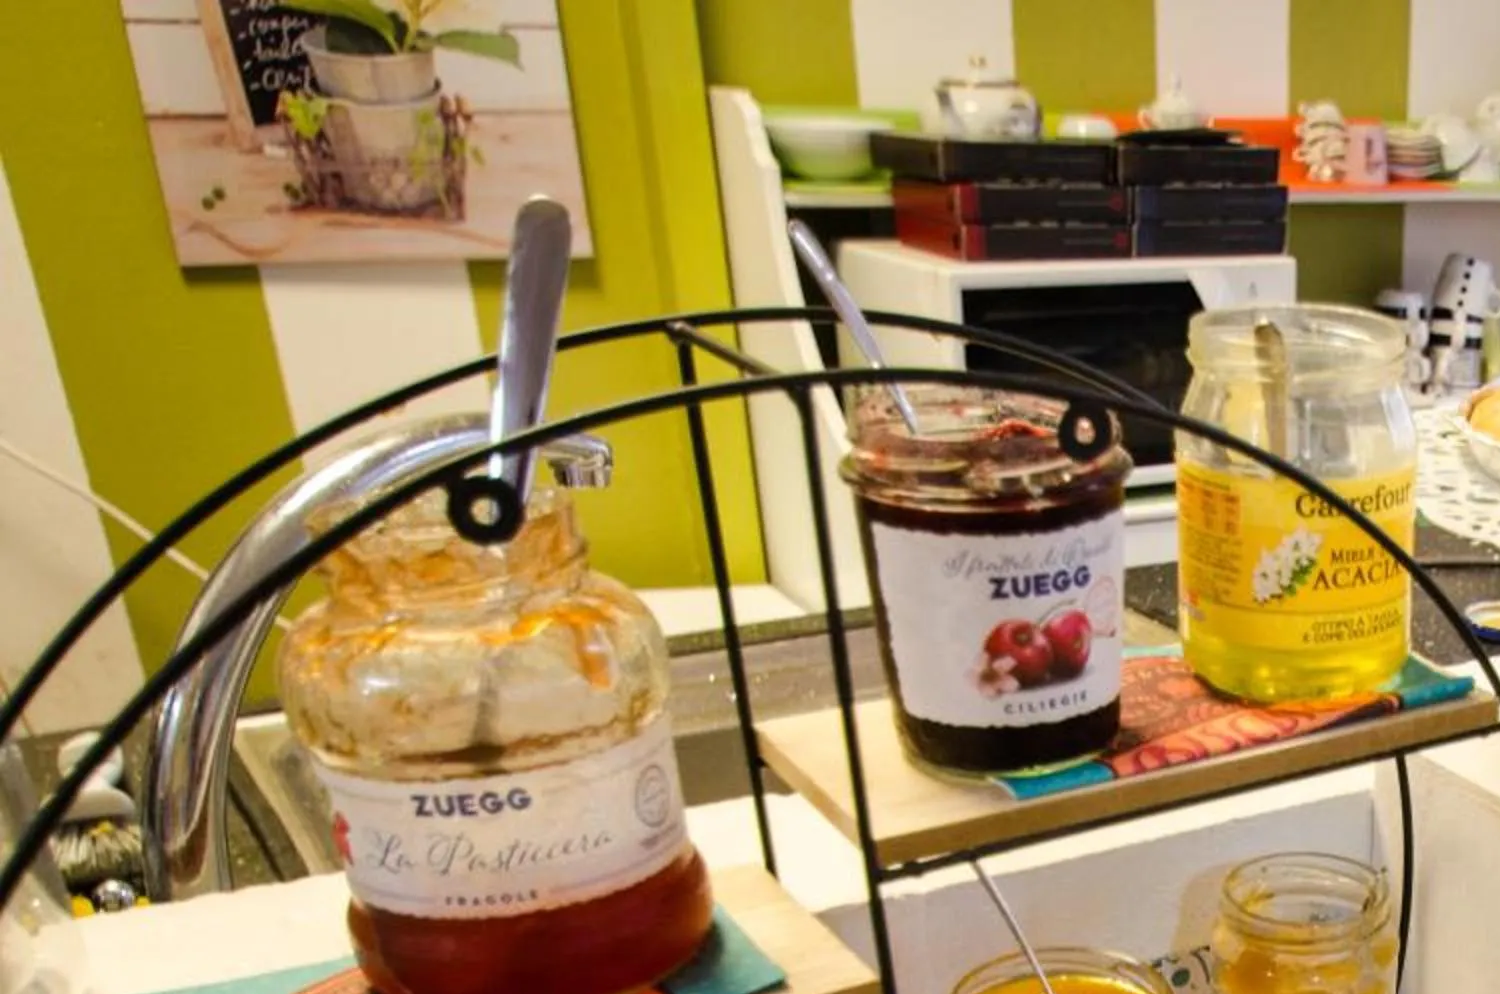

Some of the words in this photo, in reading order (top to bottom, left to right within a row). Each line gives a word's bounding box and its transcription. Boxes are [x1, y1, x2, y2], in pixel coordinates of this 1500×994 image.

[987, 564, 1092, 601] ZUEGG
[1003, 689, 1088, 714] CILIEGIE
[410, 786, 533, 818] ZUEGG
[443, 888, 539, 907] FRAGOLE
